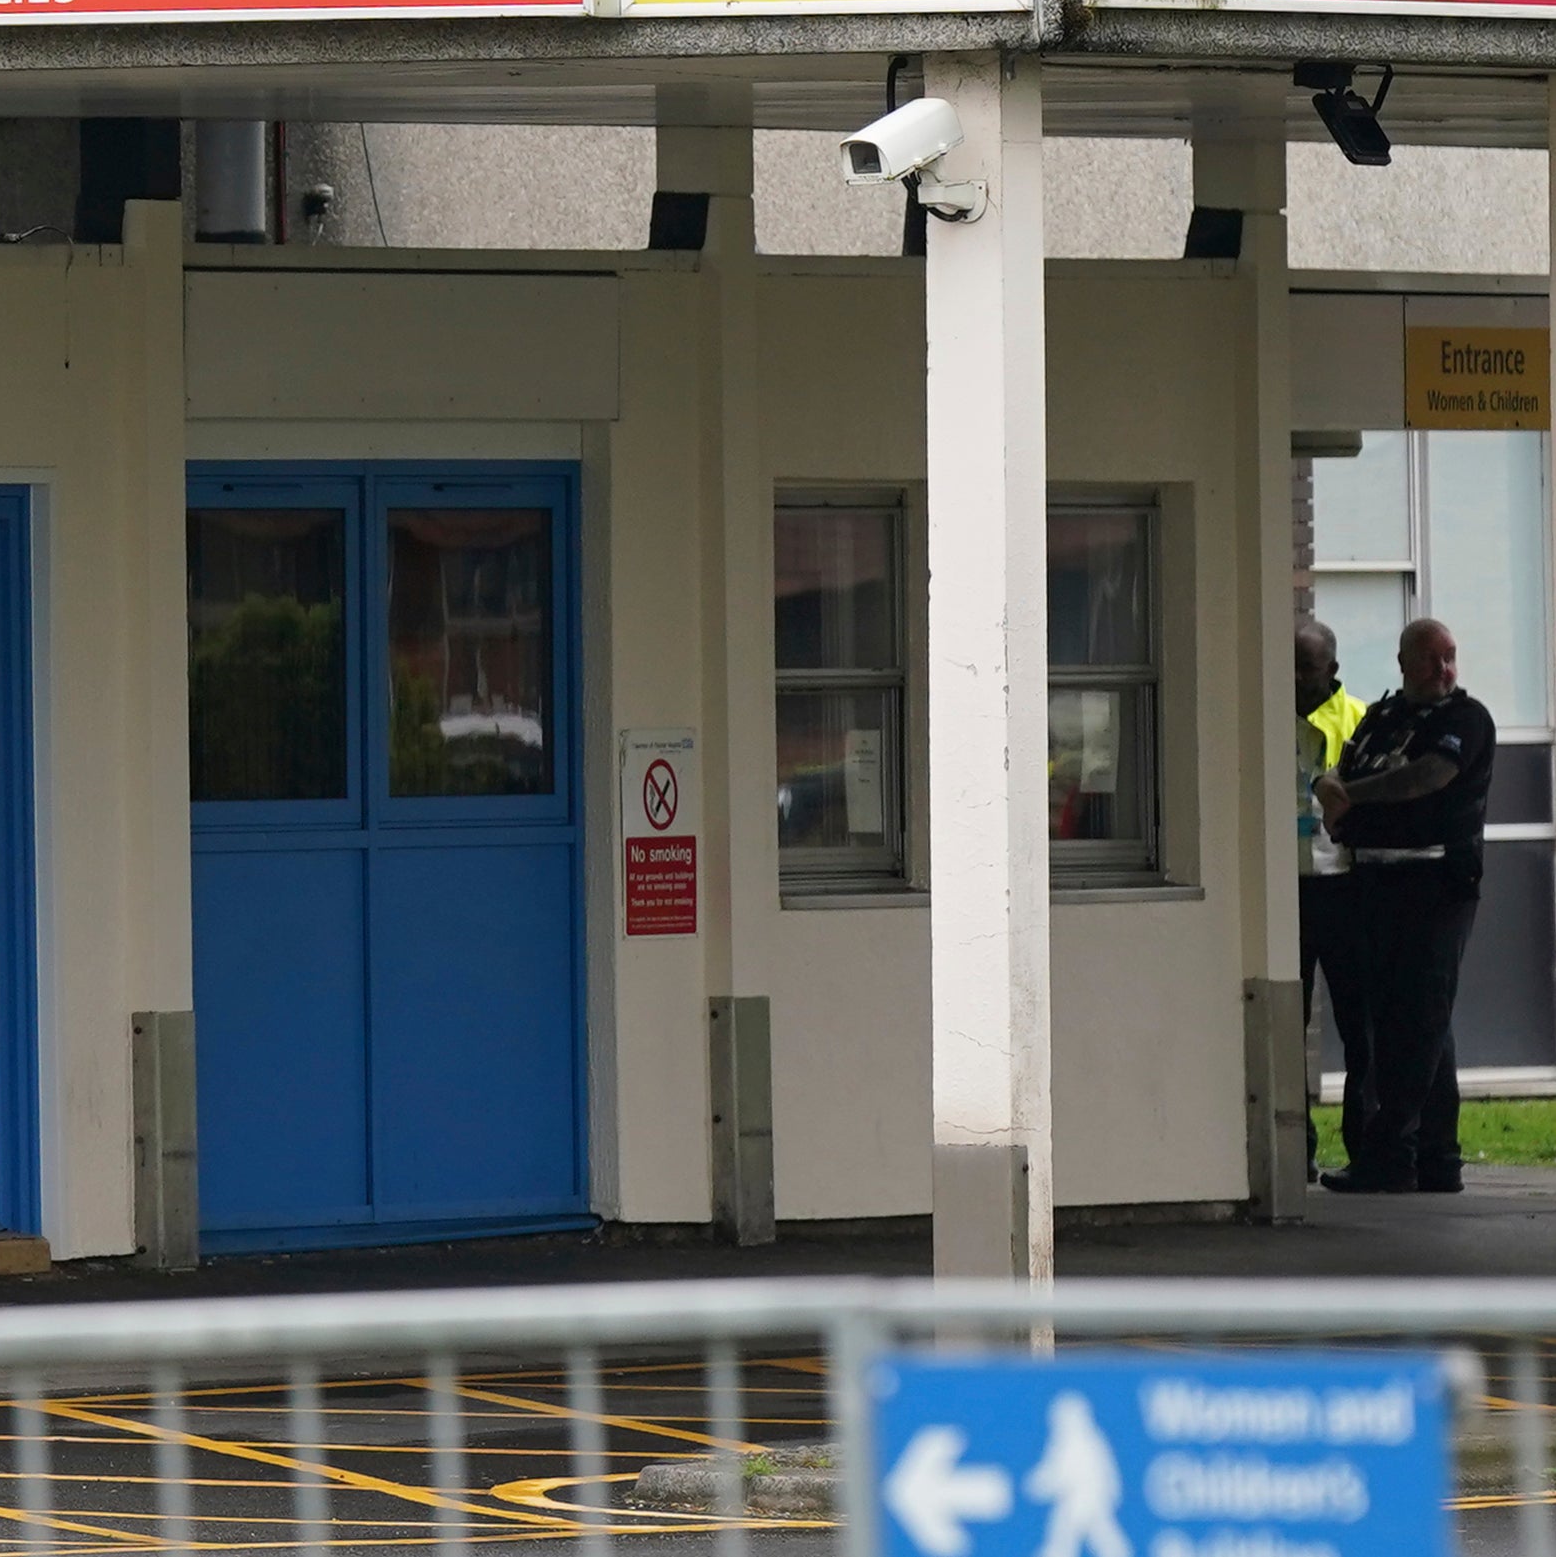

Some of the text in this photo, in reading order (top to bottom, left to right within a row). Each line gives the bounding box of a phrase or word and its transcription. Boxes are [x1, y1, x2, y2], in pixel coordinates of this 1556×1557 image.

[1441, 341, 1525, 375] Entrance
[1427, 390, 1539, 412] Women & Children
[631, 845, 692, 865] No smoking
